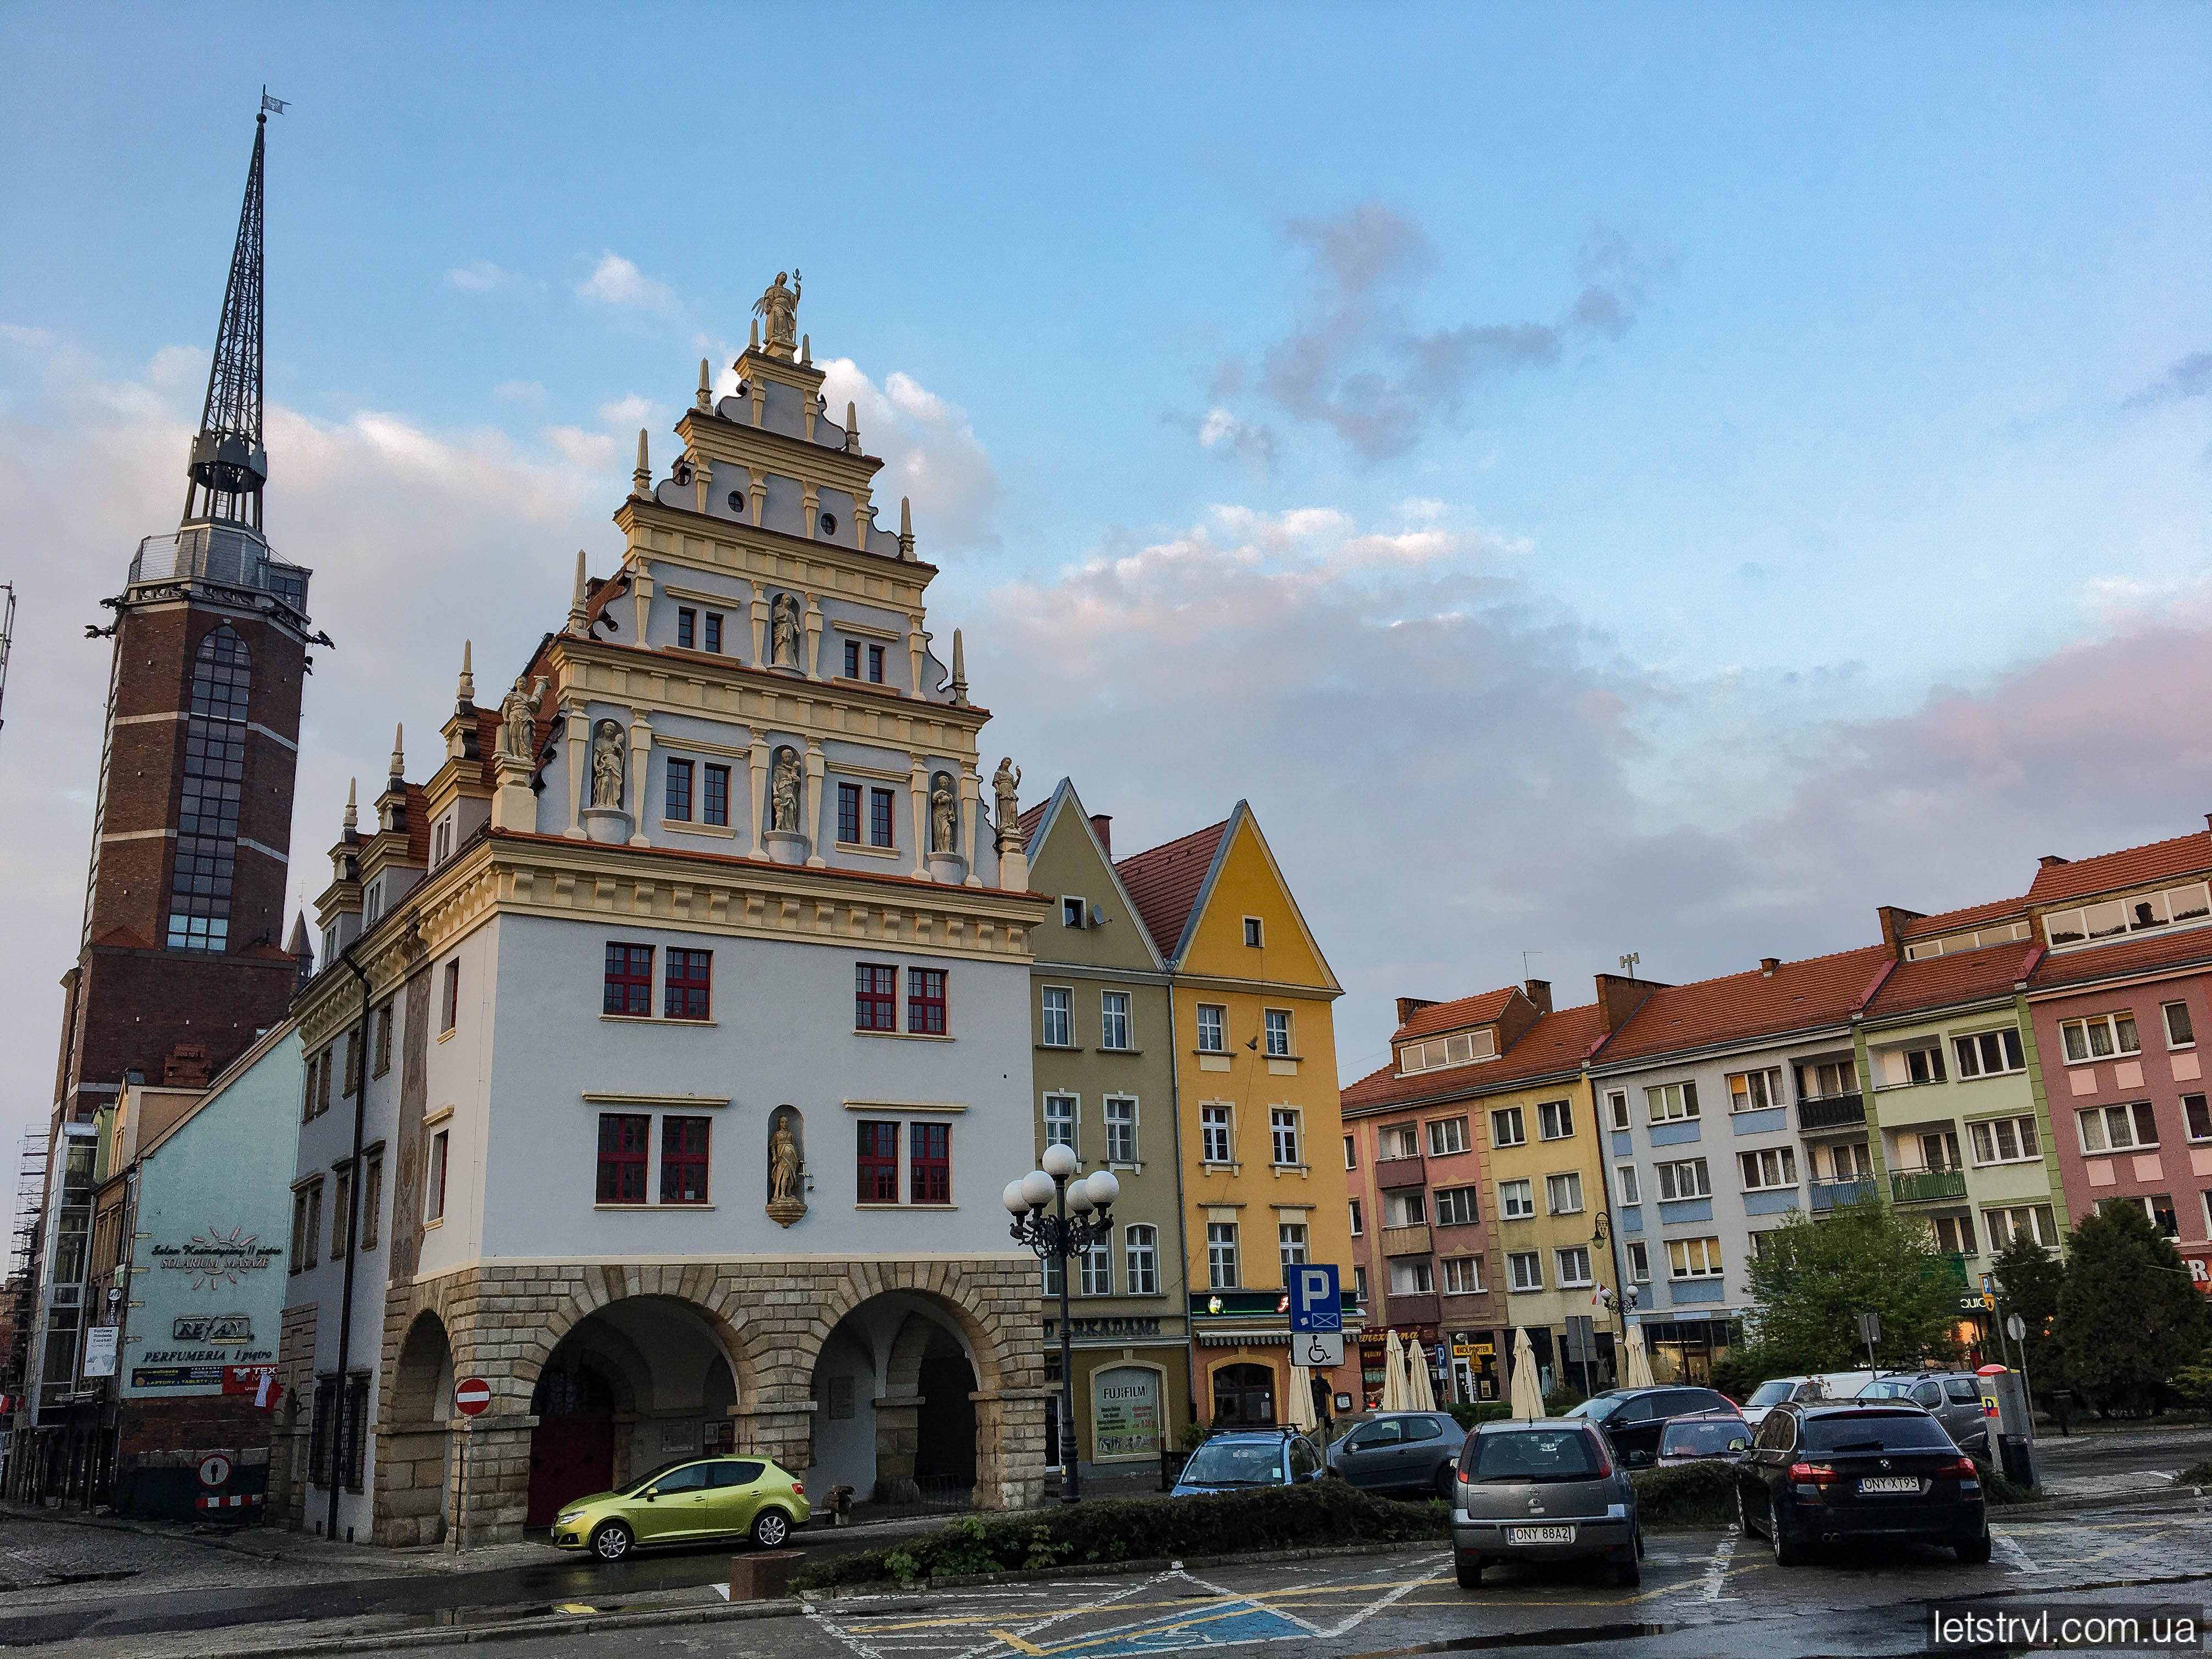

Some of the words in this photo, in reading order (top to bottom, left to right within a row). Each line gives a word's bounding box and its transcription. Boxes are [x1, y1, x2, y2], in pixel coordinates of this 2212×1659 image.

[161, 1257, 219, 1269] SOLARIUM
[1301, 1270, 1330, 1311] P
[1983, 1278, 1989, 1292] P
[1071, 1318, 1161, 1336] RKADAMI
[143, 1350, 226, 1362] PERFUMERIA
[1438, 1347, 1444, 1365] P
[1103, 1385, 1146, 1399] FUJIFILM
[1984, 1398, 1994, 1415] P
[1864, 1479, 1886, 1489] ONY
[1889, 1477, 1917, 1489] XT95
[1516, 1528, 1538, 1540] ONY
[1542, 1527, 1568, 1539] 88A2
